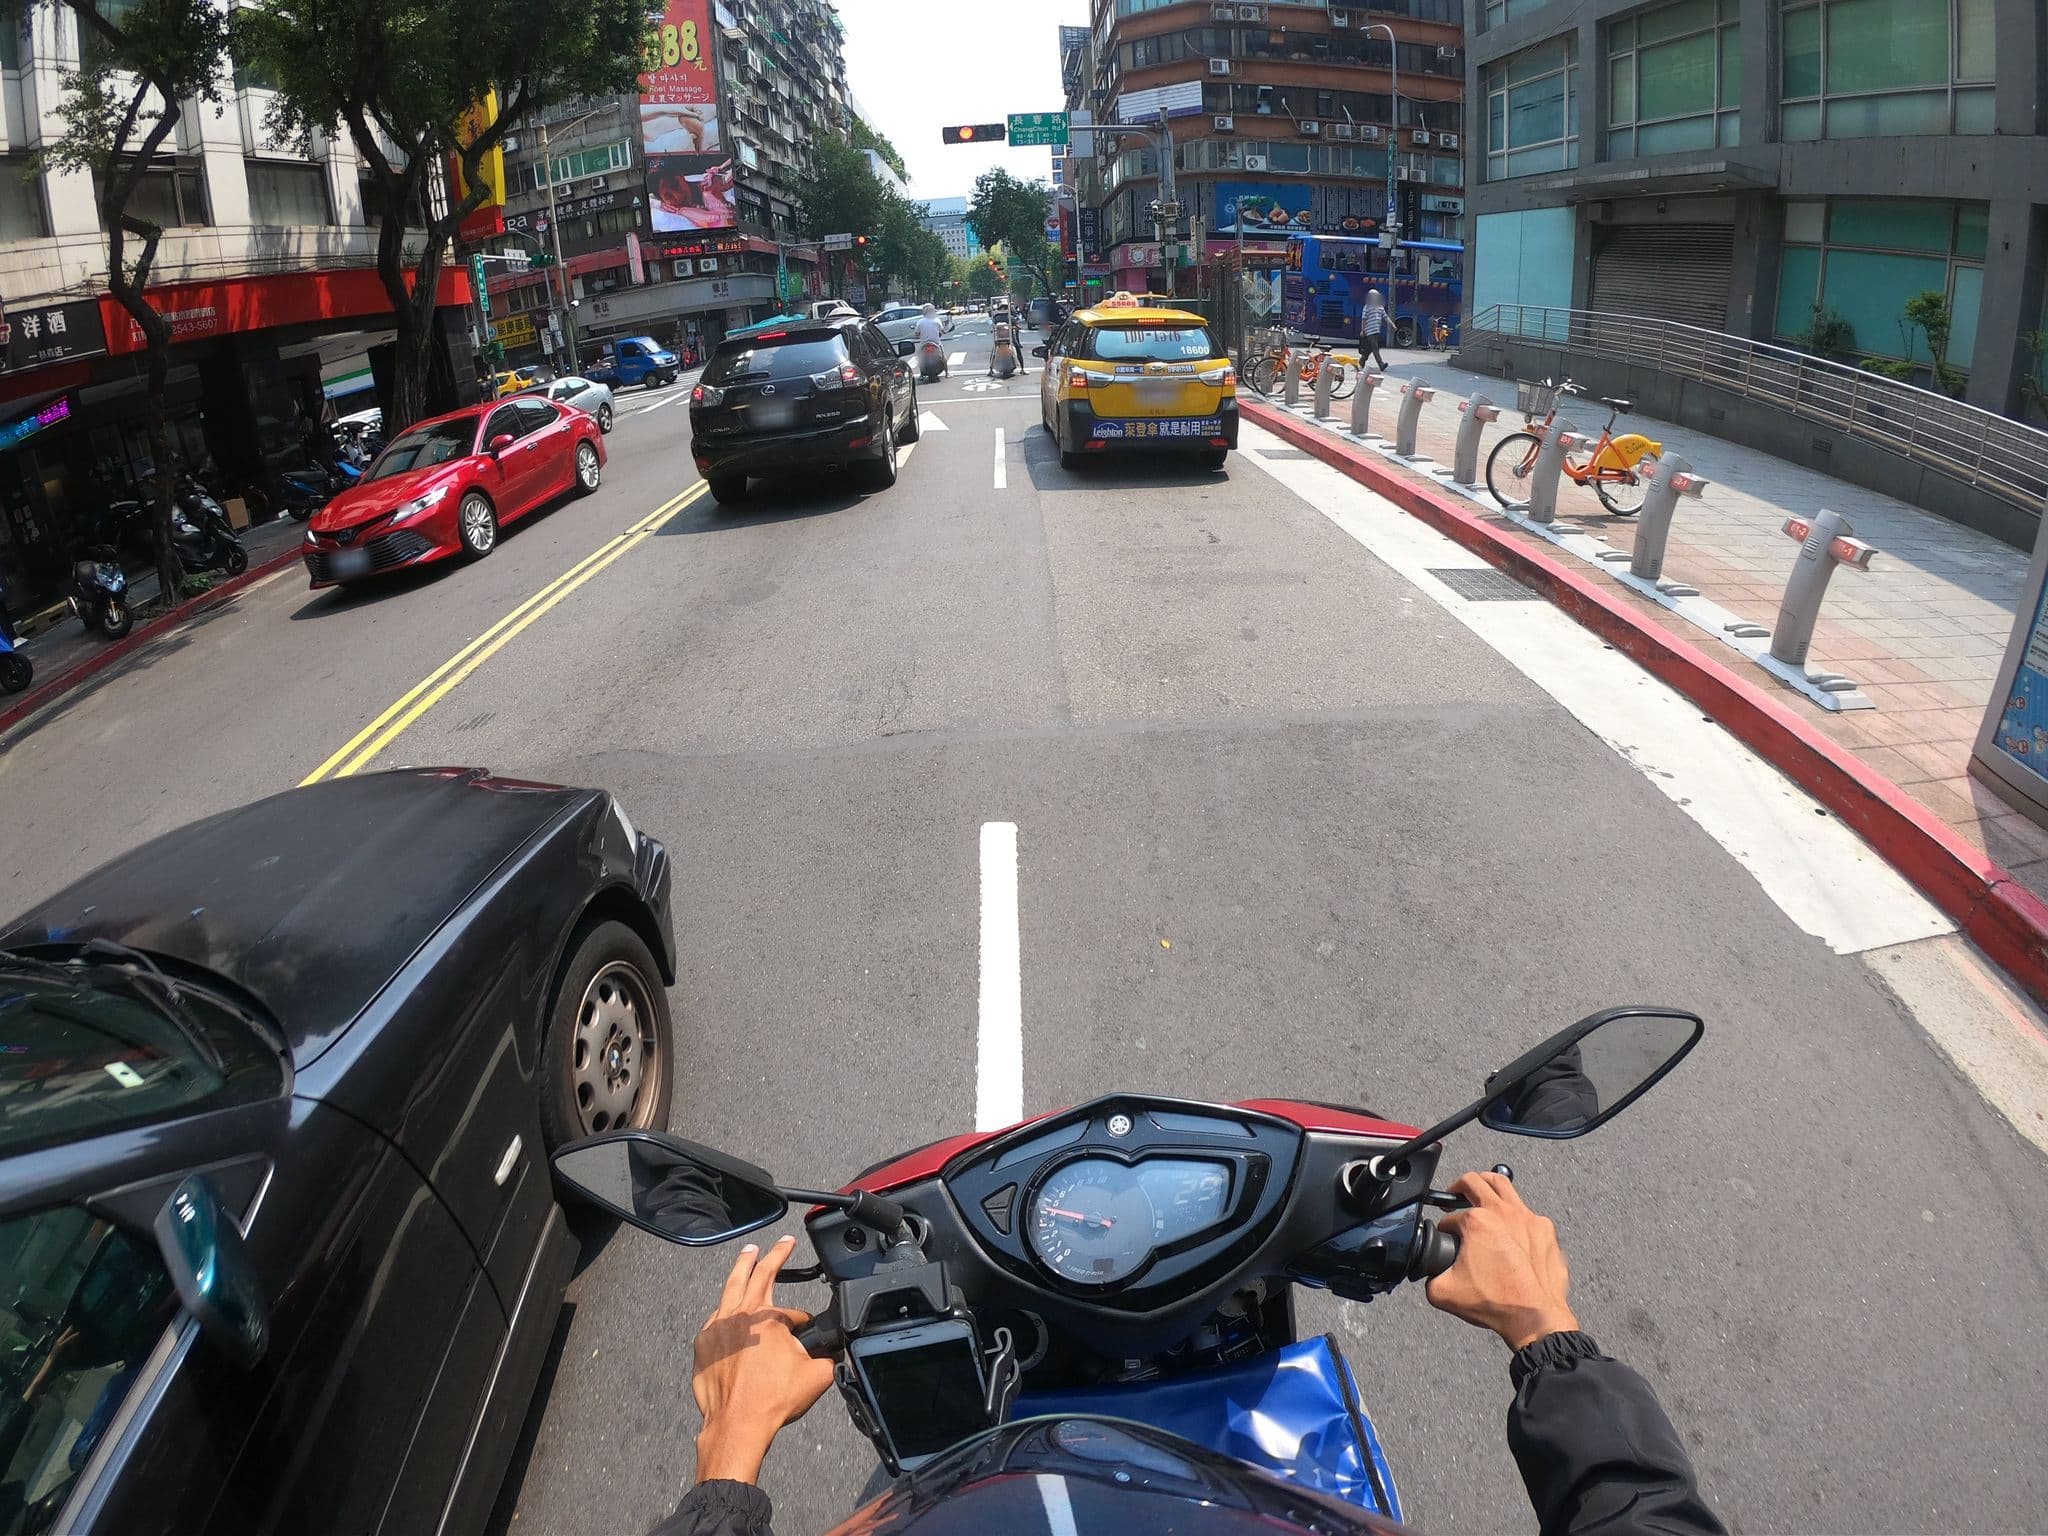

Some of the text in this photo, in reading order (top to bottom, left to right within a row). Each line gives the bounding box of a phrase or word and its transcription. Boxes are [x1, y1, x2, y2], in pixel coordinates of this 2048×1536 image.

[660, 74, 687, 83] 마사지
[669, 85, 702, 94] Massage
[1013, 114, 1061, 125] 長春路
[22, 310, 67, 339] 洋酒
[1180, 345, 1211, 355] 18600
[1093, 427, 1123, 439] Leighton
[1124, 422, 1158, 437] 萊登傘
[1159, 421, 1201, 437] 就是耐用
[1060, 1190, 1067, 1199] 6
[1053, 1199, 1060, 1208] 5
[1049, 1219, 1056, 1228] 3
[1051, 1229, 1058, 1238] 2
[1064, 1248, 1071, 1257] 0
